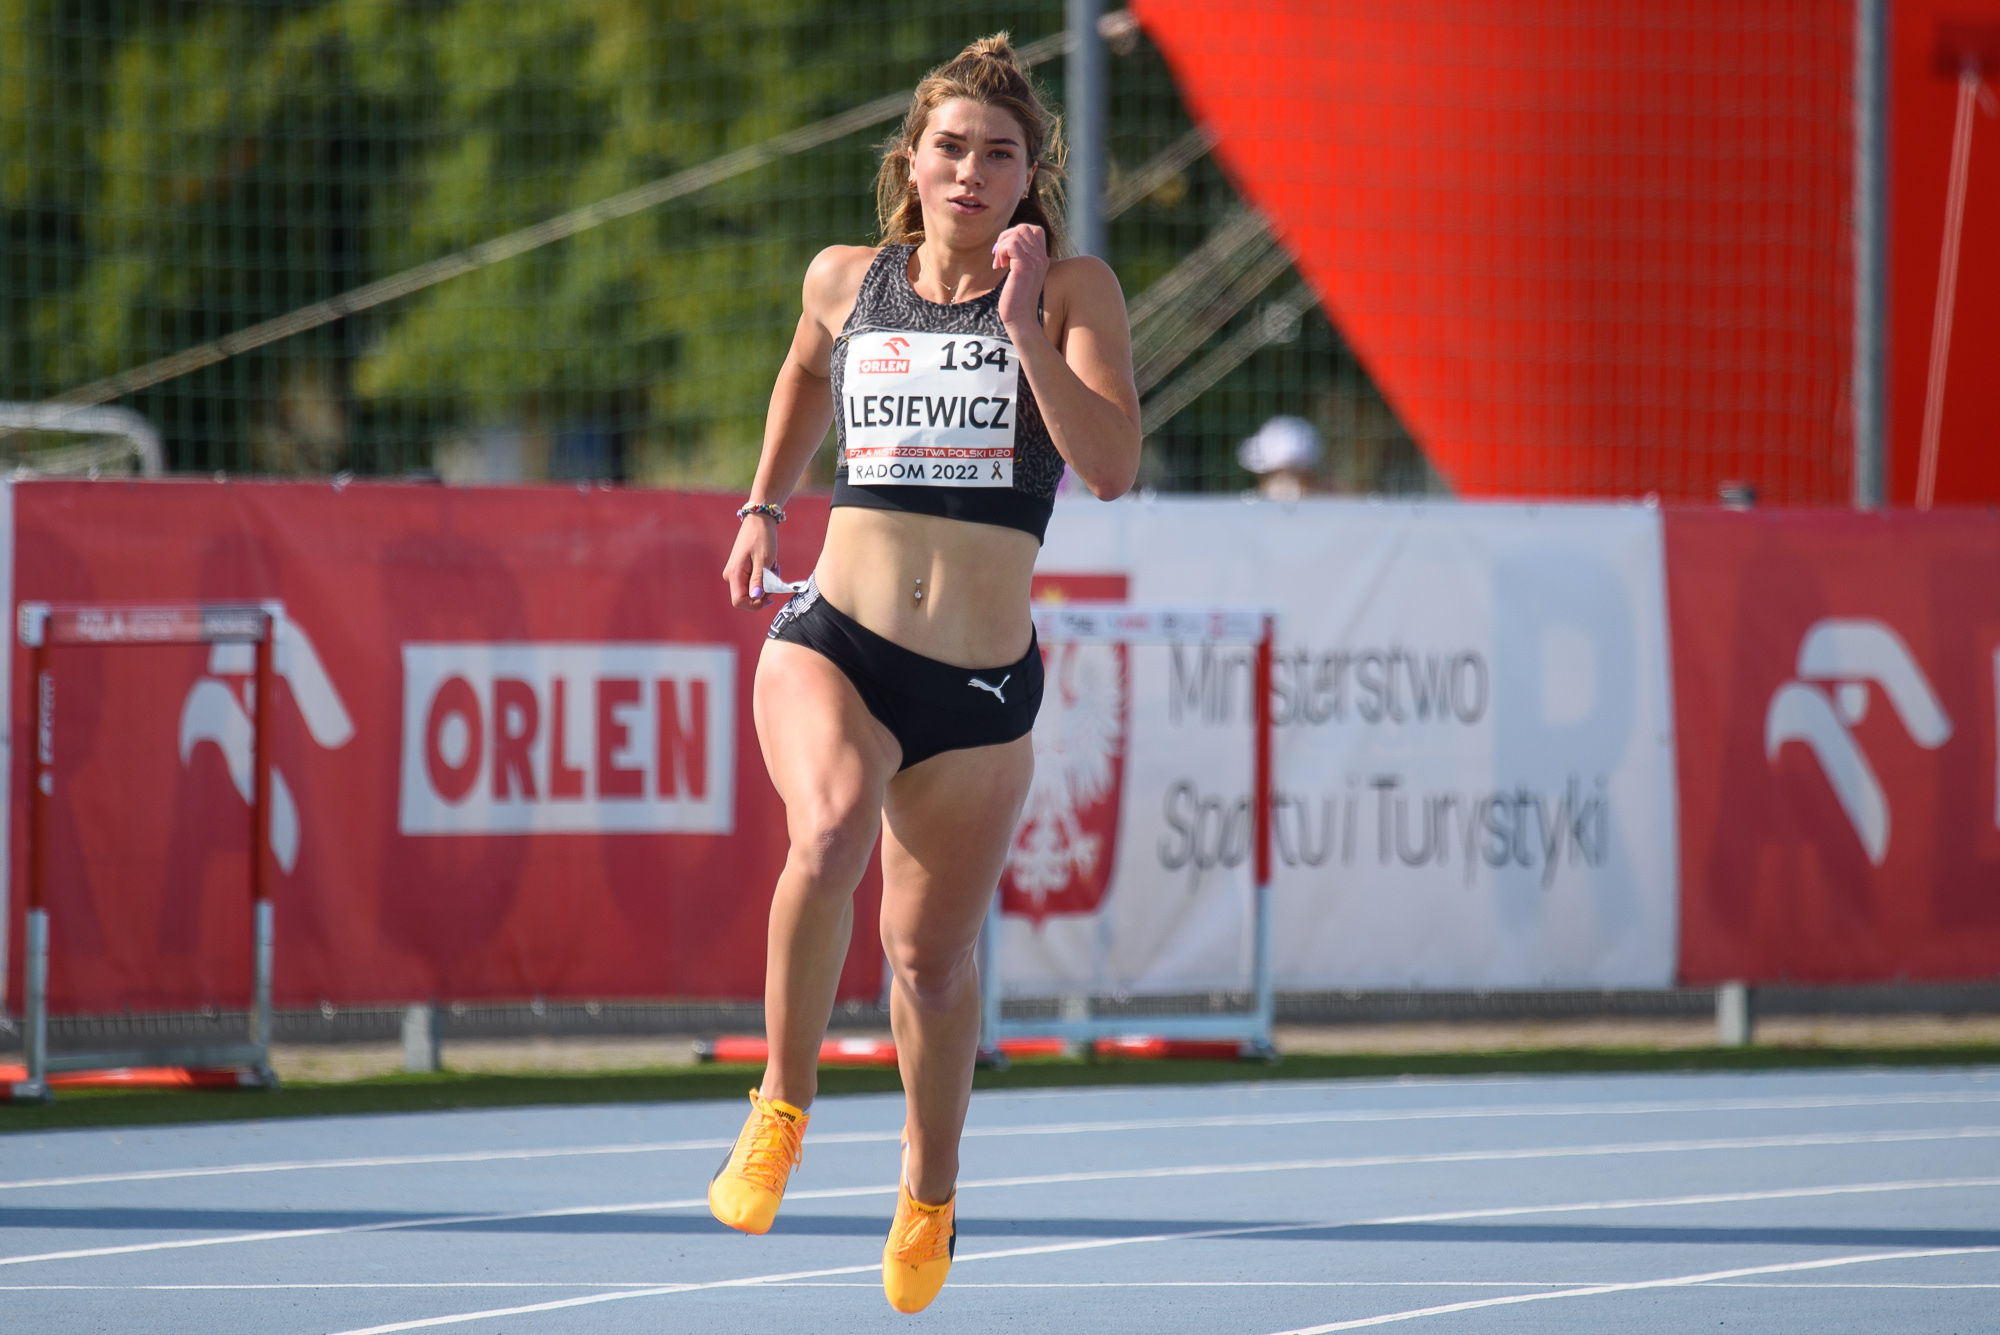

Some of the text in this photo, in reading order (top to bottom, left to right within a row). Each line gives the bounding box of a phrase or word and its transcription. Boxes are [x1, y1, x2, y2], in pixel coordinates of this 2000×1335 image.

[860, 360, 909, 373] ORLEN
[939, 340, 1009, 373] 134
[850, 395, 1010, 429] LESIEWICZ
[849, 447, 1011, 459] PZLA MISTRZOSTWA POLSKI U20
[856, 463, 979, 480] RADOM 2022
[1168, 643, 1489, 727] Minsterstwo
[423, 674, 709, 809] ORLEN
[1157, 778, 1335, 895] Spotu
[1366, 772, 1609, 891] Turystyki
